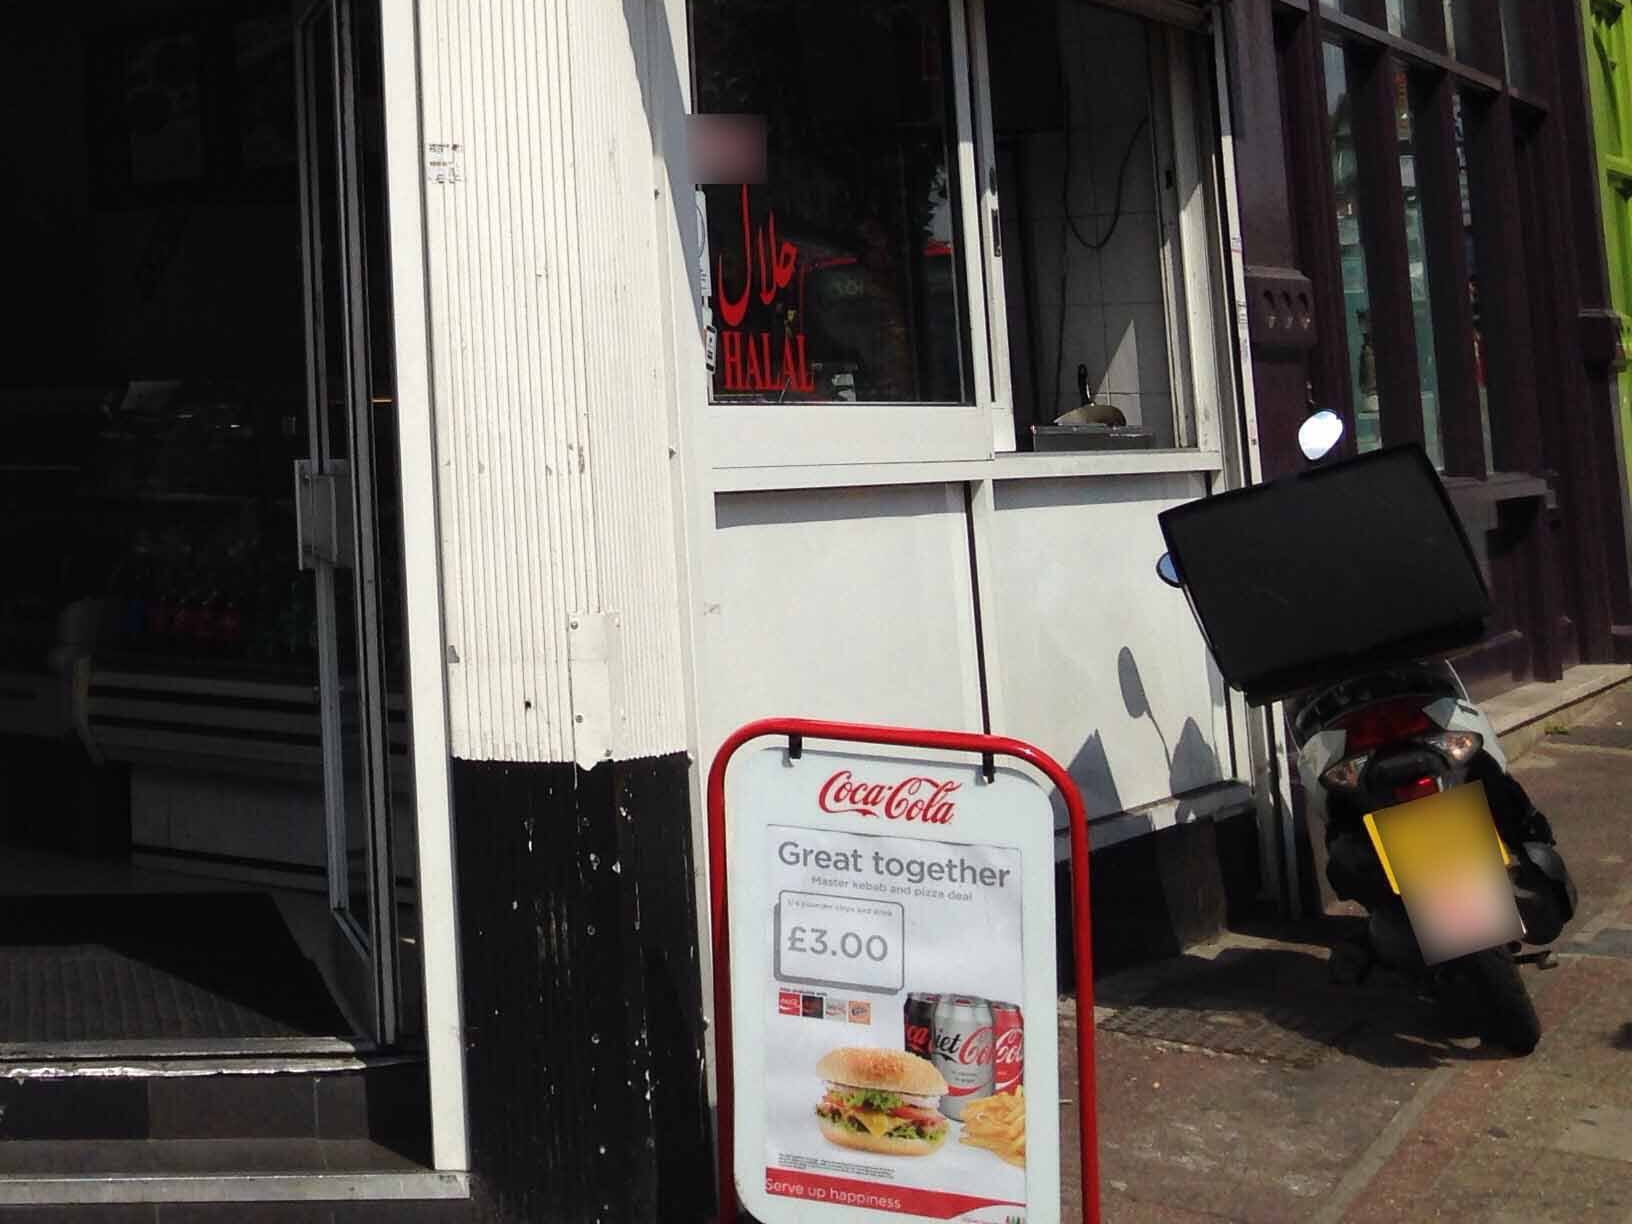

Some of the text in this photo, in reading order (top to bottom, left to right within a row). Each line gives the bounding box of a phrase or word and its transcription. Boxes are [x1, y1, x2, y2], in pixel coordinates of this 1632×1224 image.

[721, 330, 816, 393] HALAL
[818, 770, 962, 825] Coca-Cola
[778, 841, 1011, 888] Great together
[811, 876, 973, 902] Master kebab and pizza deal
[787, 925, 888, 962] £3.00
[935, 1028, 961, 1054] iet
[766, 1177, 902, 1210] Serve up happiness
